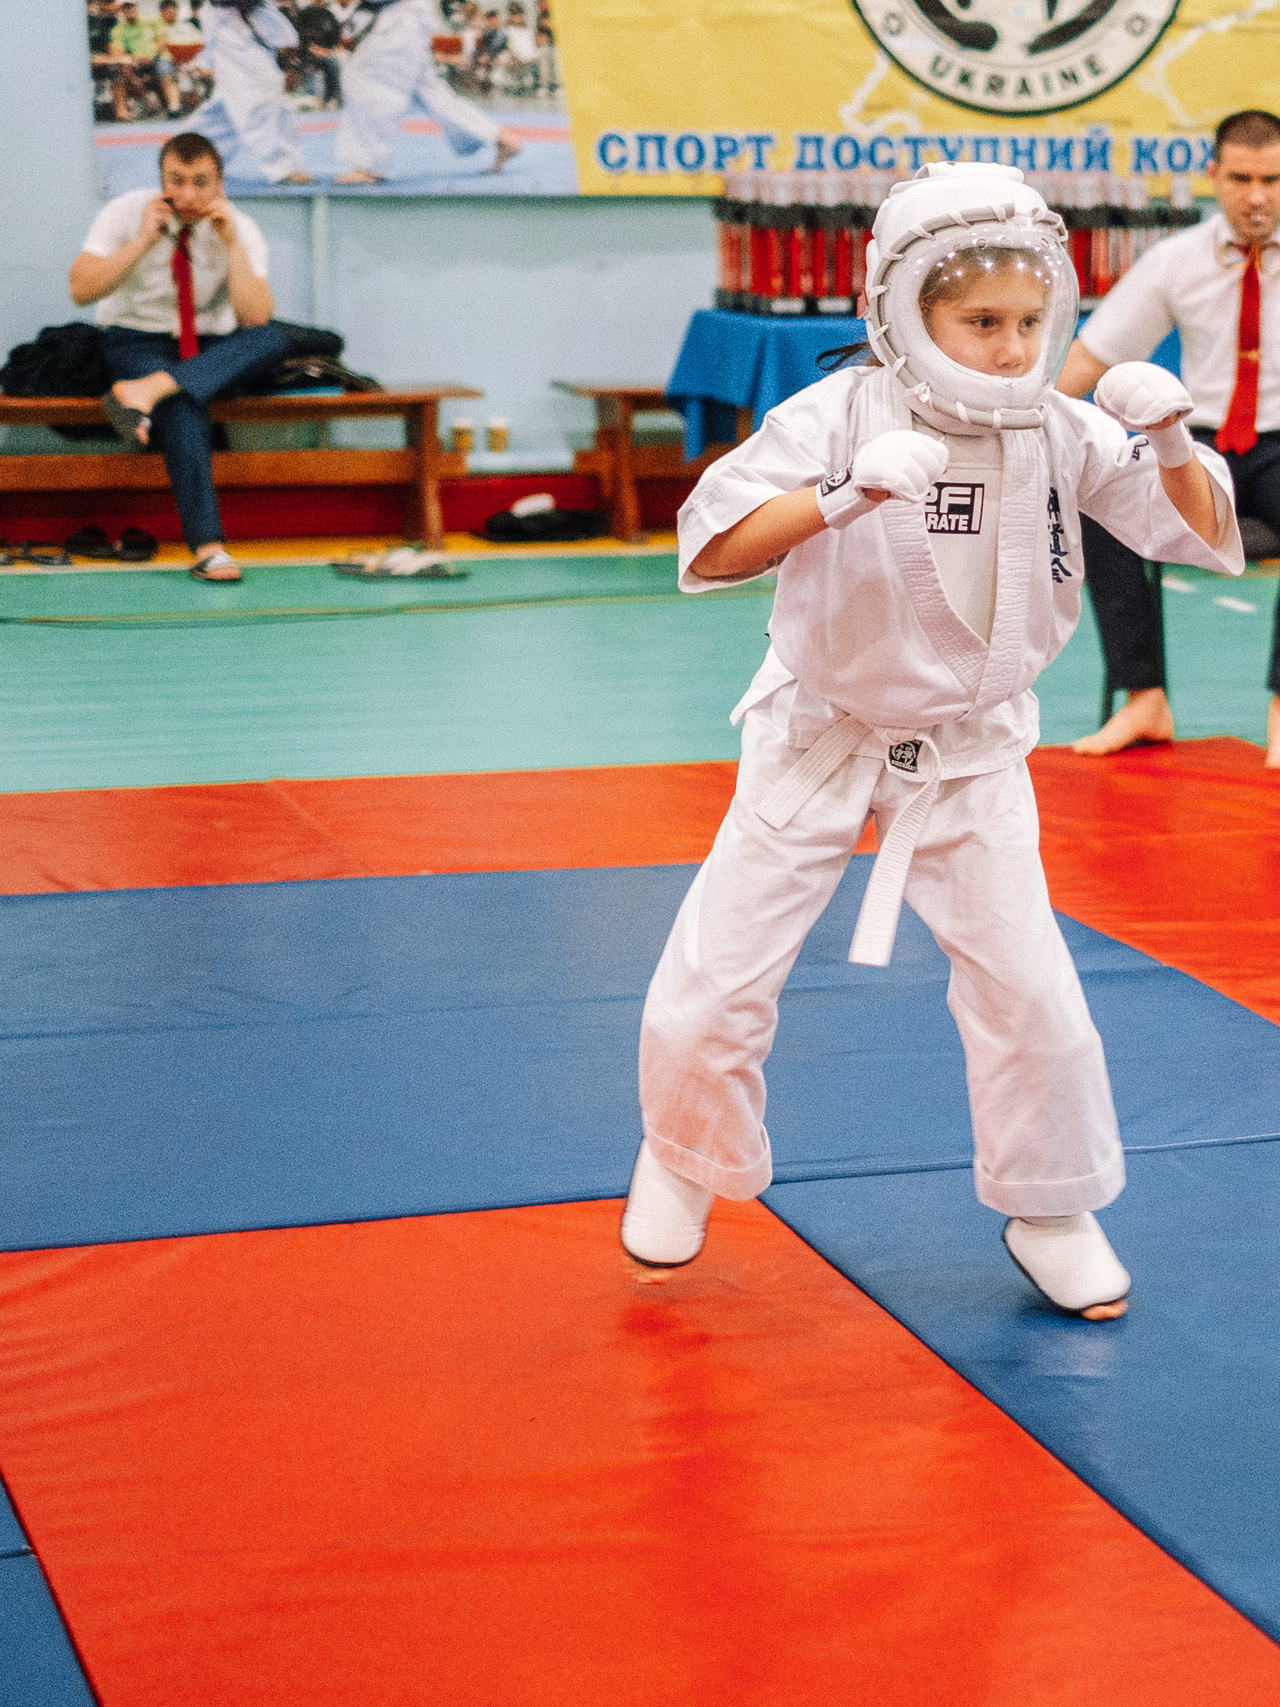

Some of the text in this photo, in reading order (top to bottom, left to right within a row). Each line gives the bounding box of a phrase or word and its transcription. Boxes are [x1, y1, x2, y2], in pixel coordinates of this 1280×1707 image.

[930, 54, 1102, 96] UKRAINE
[599, 132, 774, 171] СПОРТ
[795, 124, 1110, 171] ДОСТУПНИЙ
[926, 513, 969, 531] RATE
